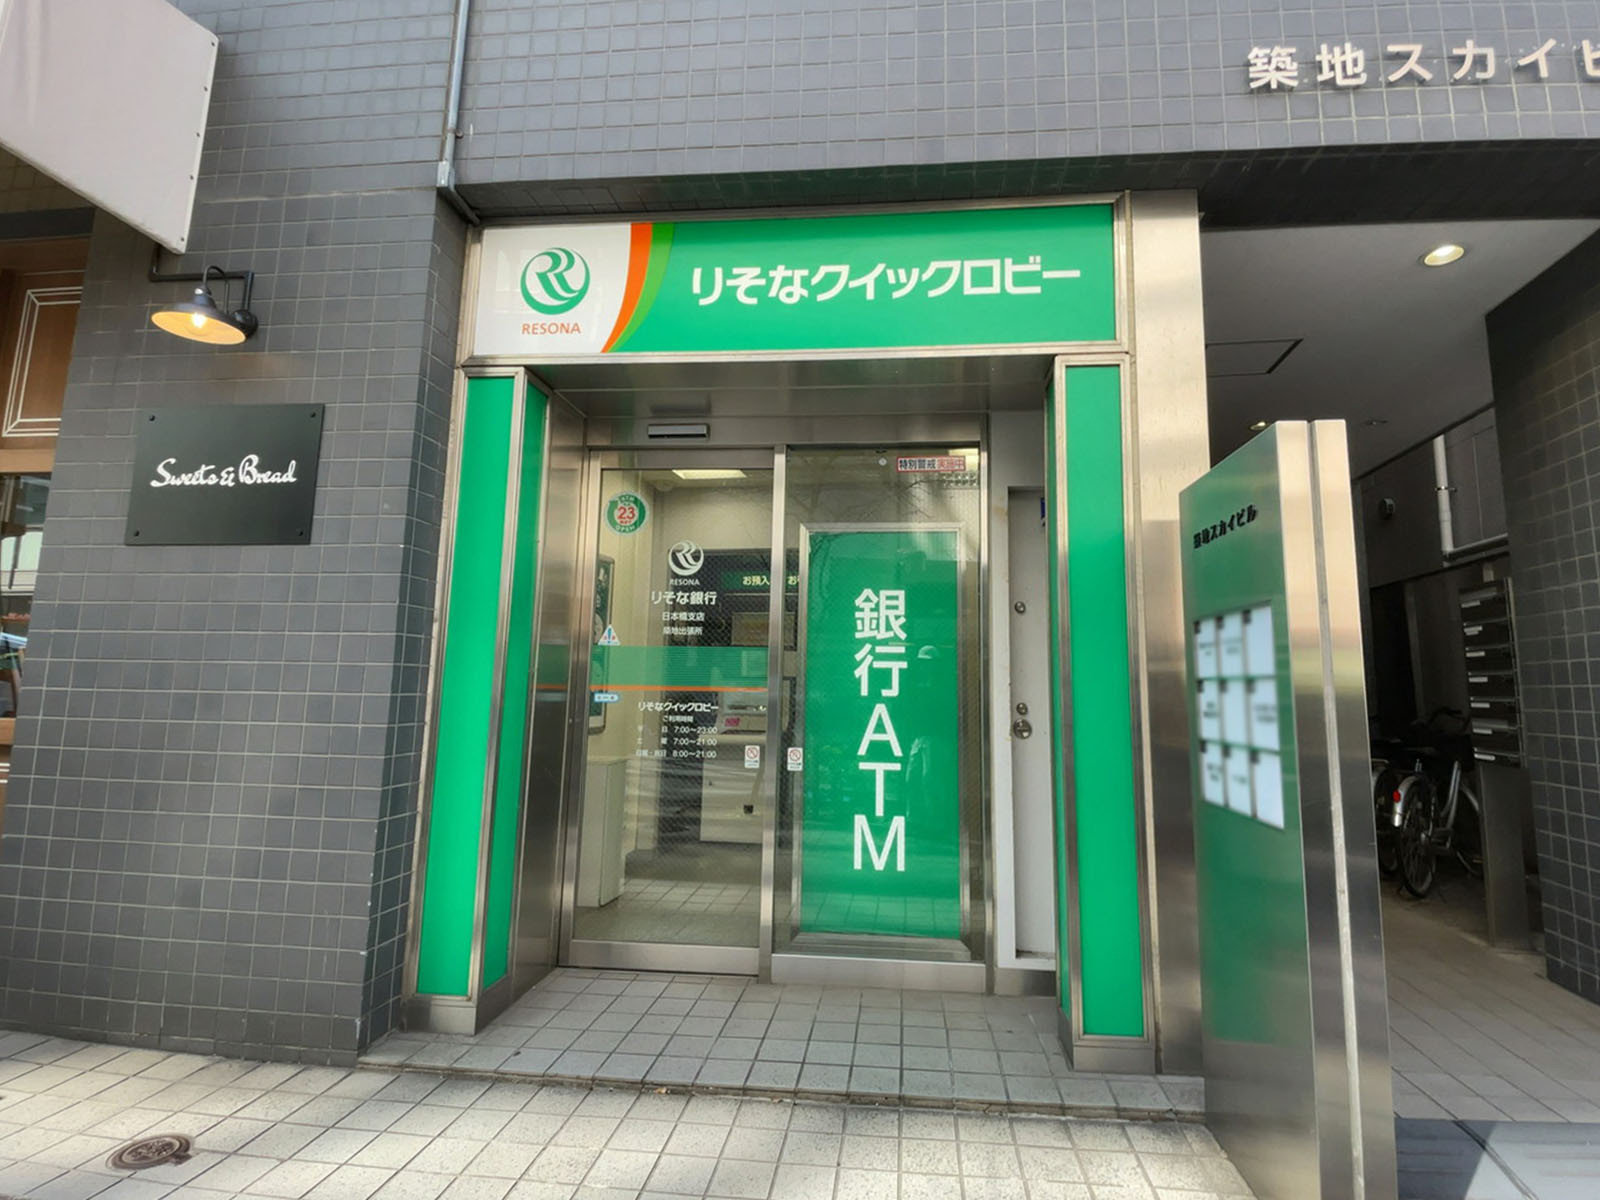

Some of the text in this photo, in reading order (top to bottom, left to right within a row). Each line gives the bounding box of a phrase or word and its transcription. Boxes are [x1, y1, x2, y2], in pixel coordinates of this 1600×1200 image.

[692, 256, 1080, 306] りそなクイックロビー
[521, 322, 581, 336] RESONA
[239, 454, 298, 485] Bread
[616, 506, 636, 521] 23
[669, 578, 700, 586] RESONA
[651, 590, 718, 606] りそな銀行
[853, 587, 909, 873] 銀行ATM
